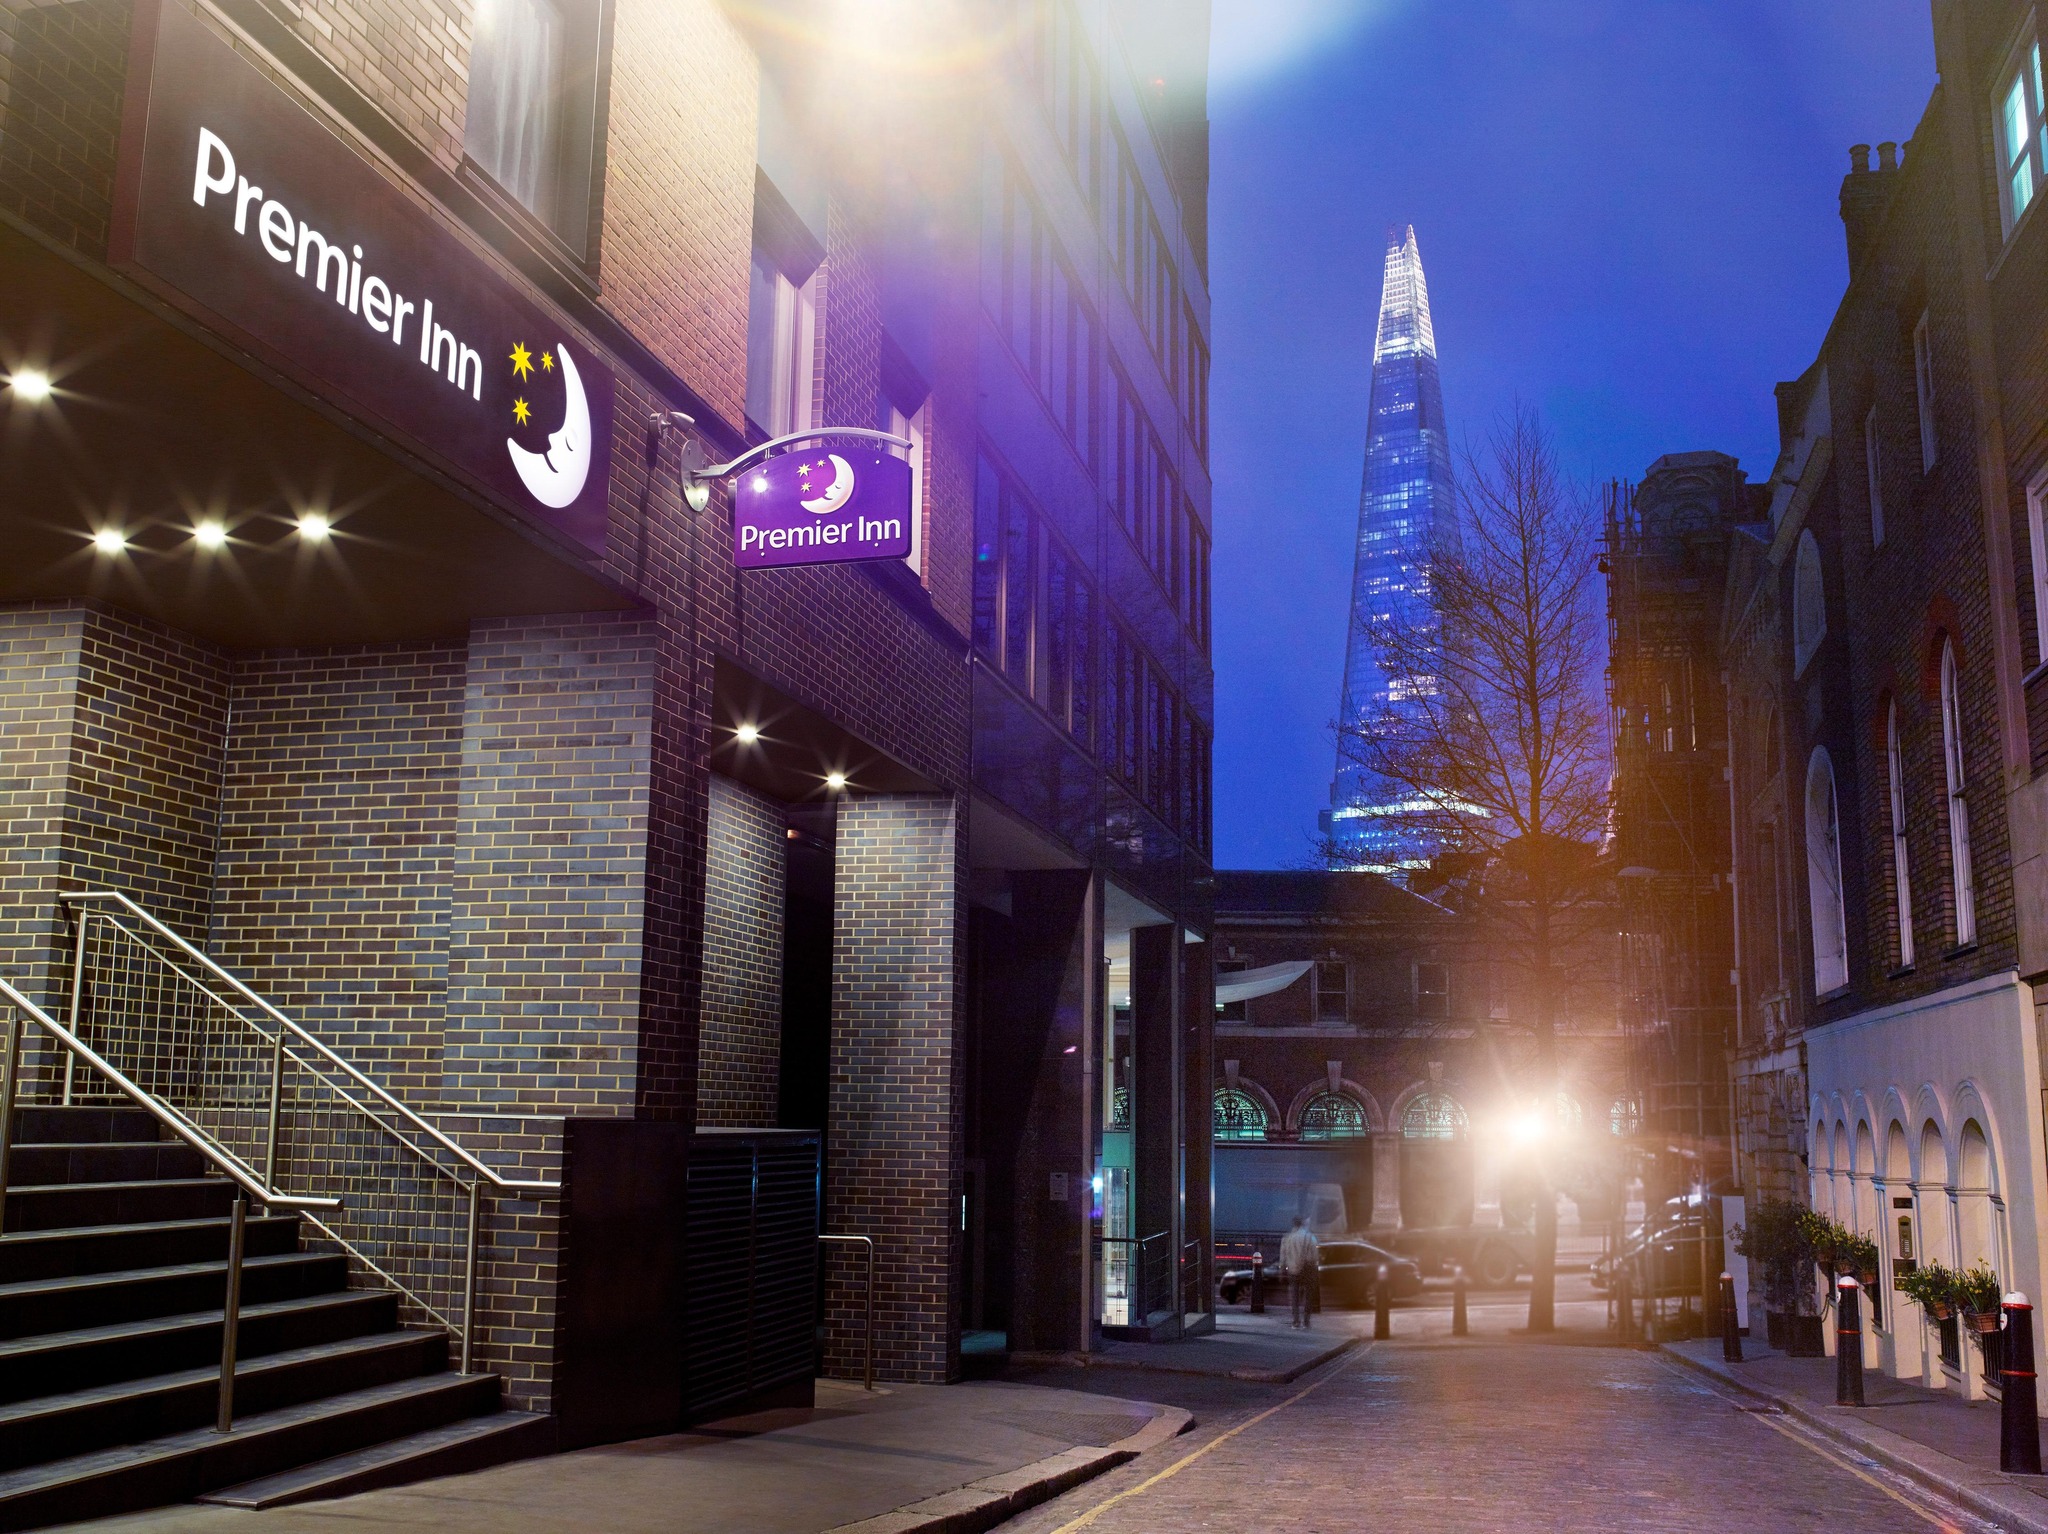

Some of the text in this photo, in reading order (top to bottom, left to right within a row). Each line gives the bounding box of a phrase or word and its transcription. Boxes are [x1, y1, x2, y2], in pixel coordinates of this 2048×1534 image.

[193, 126, 483, 402] Premier Inn
[740, 515, 901, 551] Premier Inn
